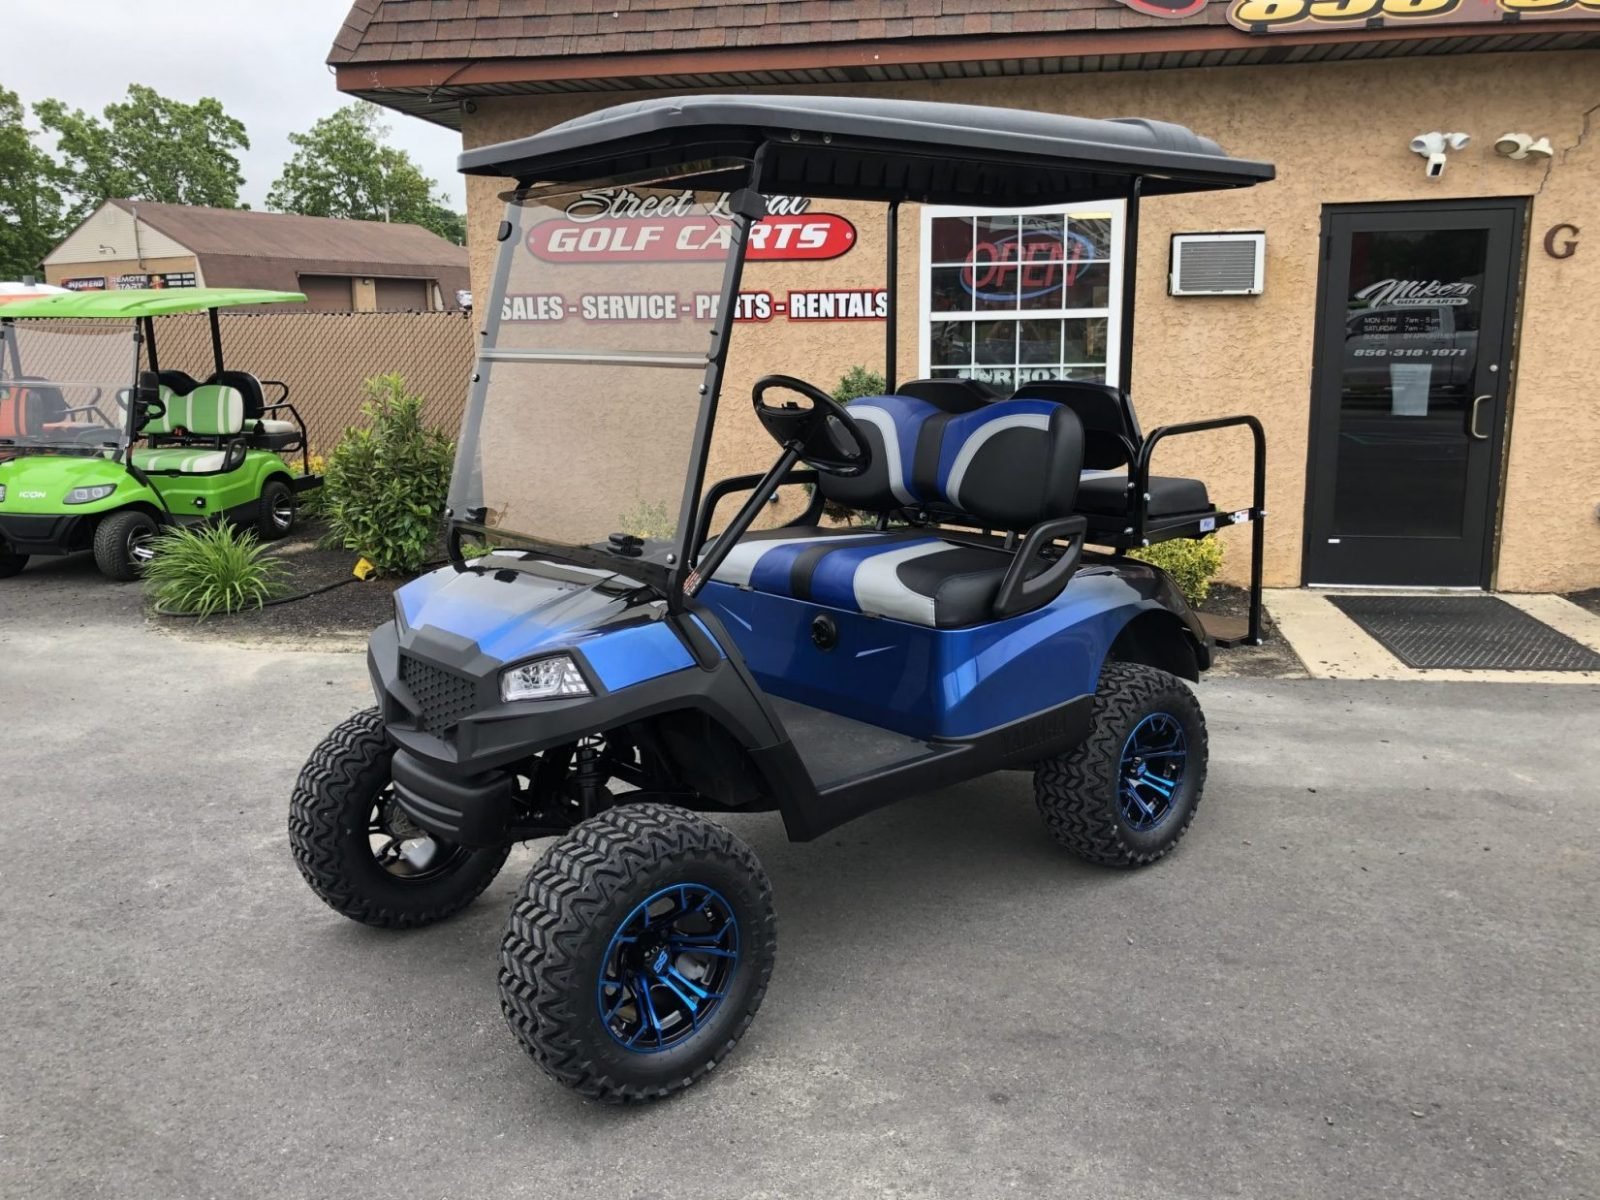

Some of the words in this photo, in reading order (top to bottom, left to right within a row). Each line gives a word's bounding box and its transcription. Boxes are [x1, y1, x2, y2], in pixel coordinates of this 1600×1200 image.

[566, 188, 694, 223] Street
[709, 191, 812, 225] Lal
[547, 226, 664, 252] GOLF
[676, 223, 831, 251] CARTS
[1543, 223, 1579, 260] G
[962, 241, 1083, 288] OPEN
[500, 295, 564, 321] SALES
[582, 295, 678, 320] SERVICE
[790, 292, 887, 319] RENTALS
[19, 491, 47, 499] ICON
